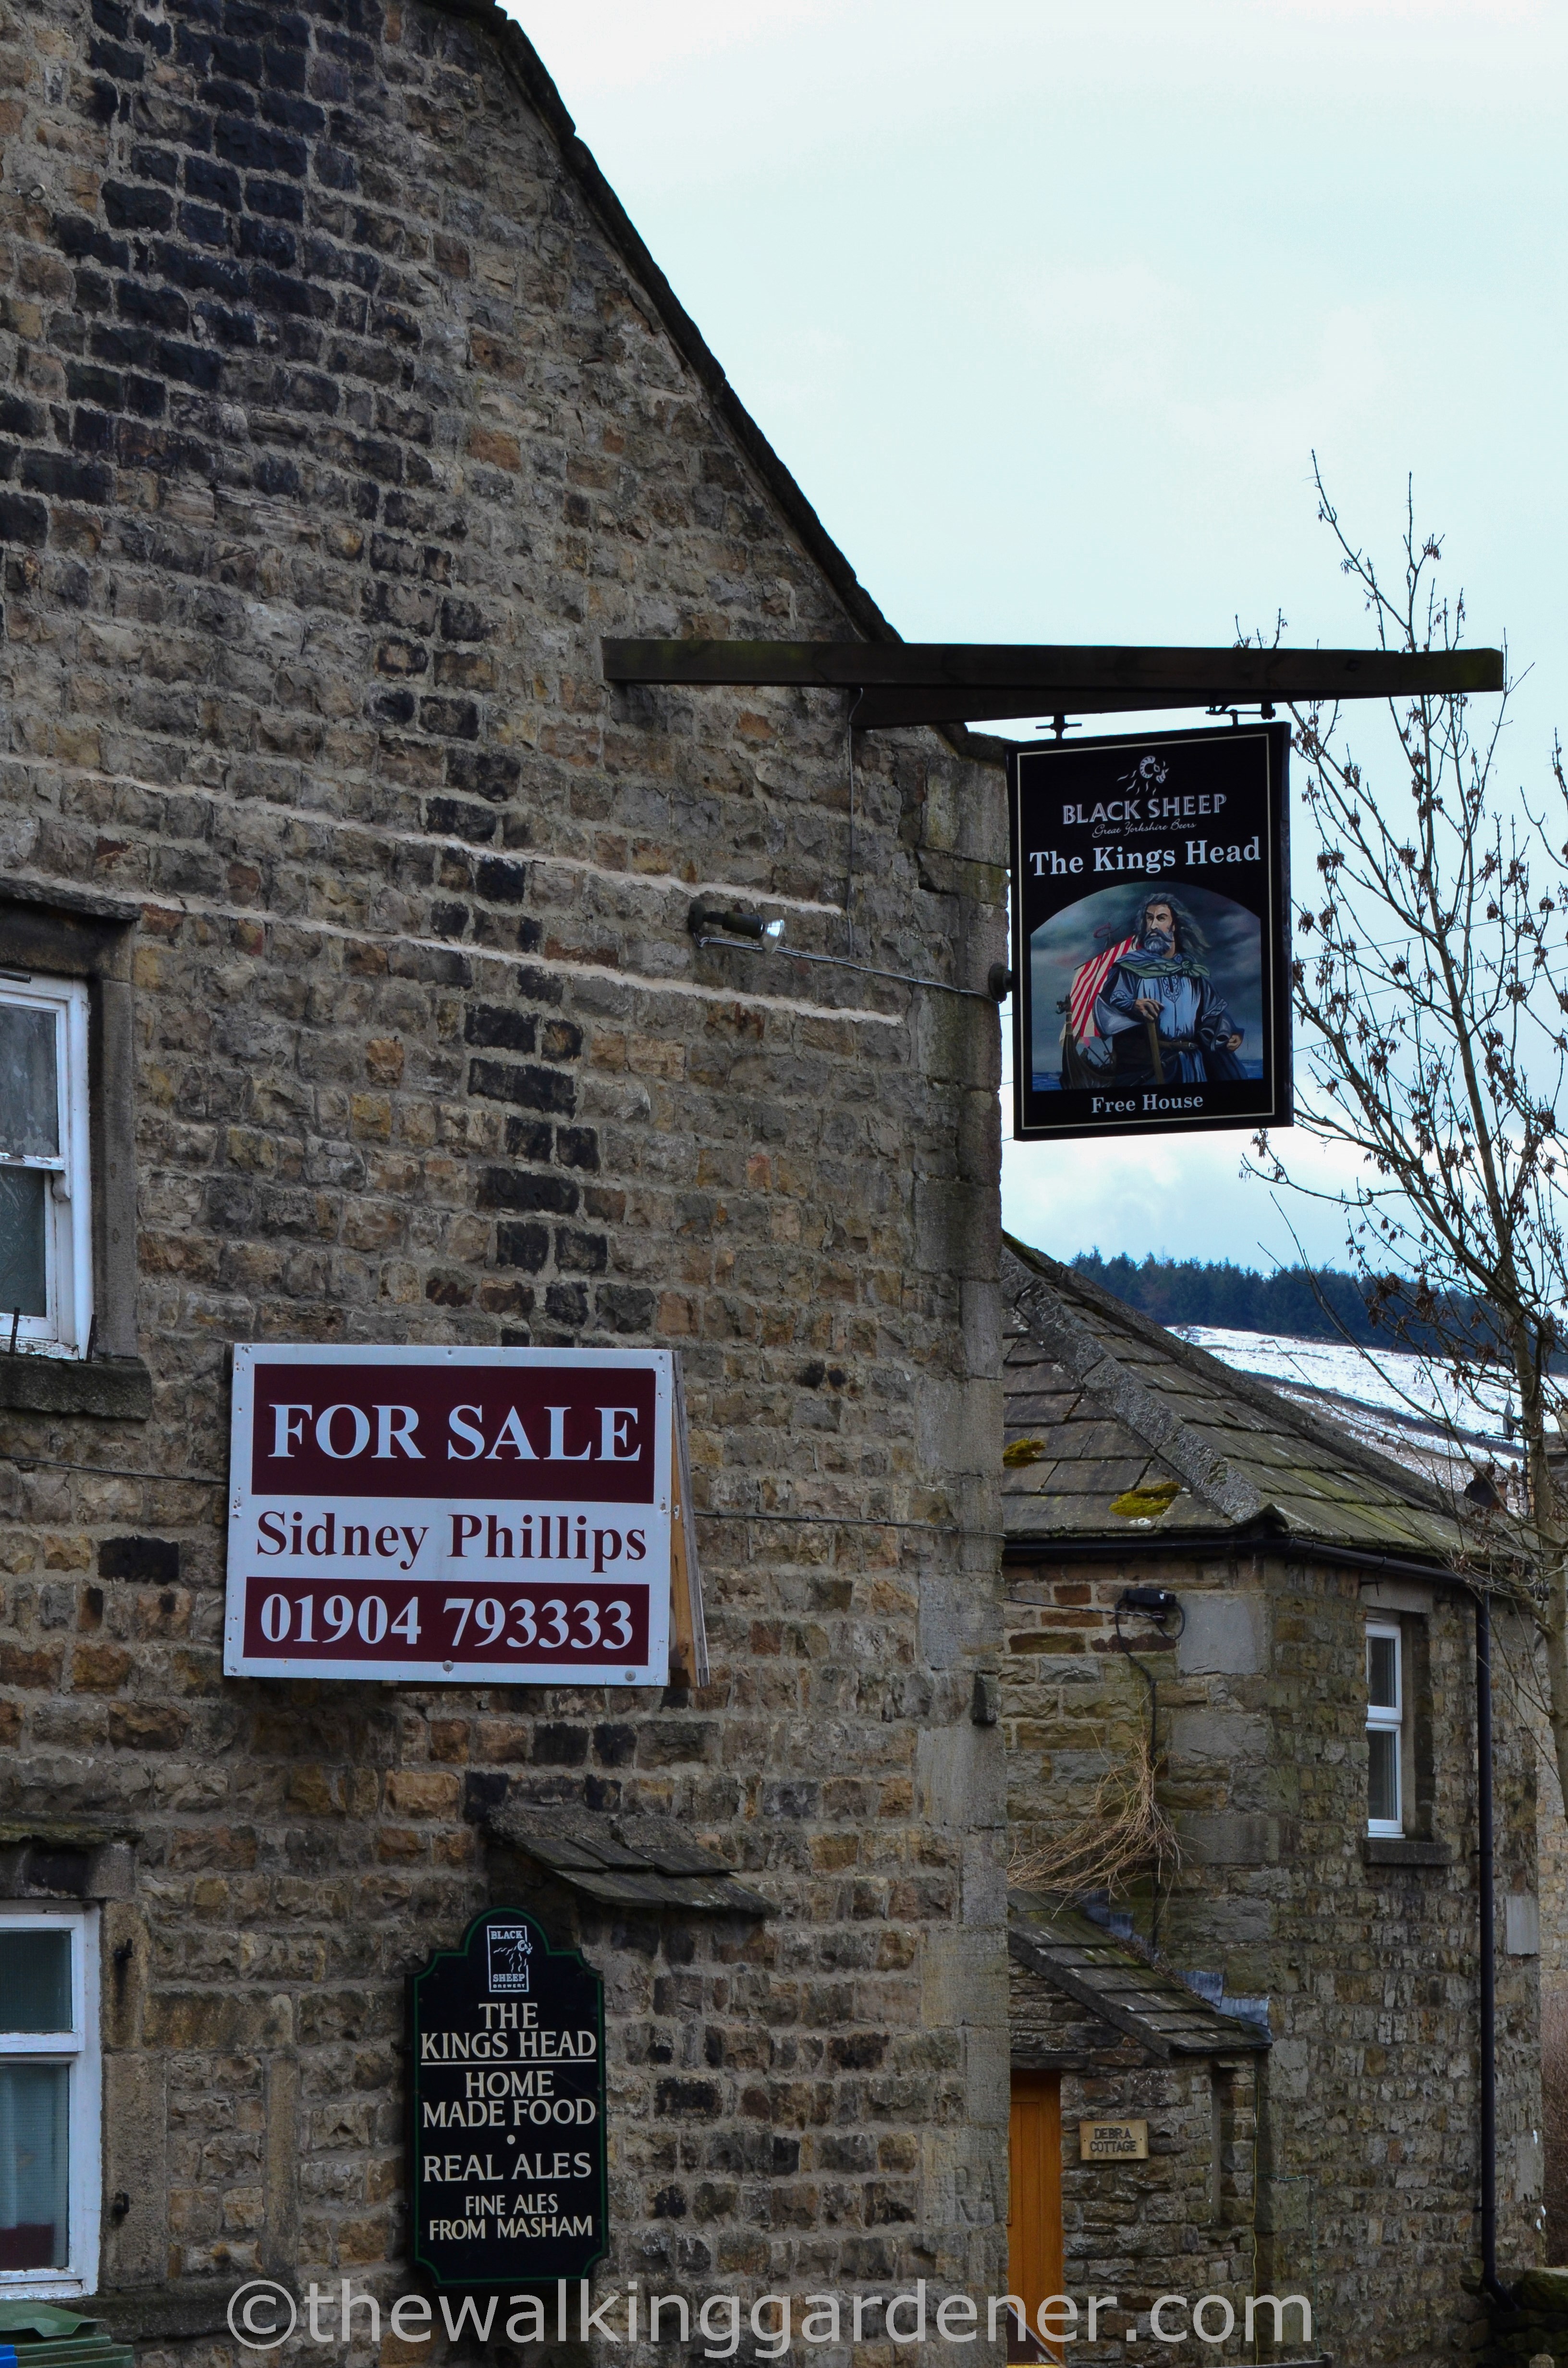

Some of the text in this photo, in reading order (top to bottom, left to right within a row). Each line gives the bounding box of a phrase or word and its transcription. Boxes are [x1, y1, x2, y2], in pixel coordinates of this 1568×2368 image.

[1063, 794, 1226, 825] BLACK SHEEP
[1092, 818, 1197, 838] Great Yorkshire Beers
[1030, 836, 1261, 876] The Kings Head
[1091, 1094, 1203, 1113] Free House
[267, 1404, 642, 1462] FOR SALE
[257, 1511, 646, 1573] Sidney Phillips
[260, 1593, 633, 1650] 01904 793333
[490, 1930, 523, 1939] BLACK
[493, 1973, 525, 1982] SHEEP
[478, 2003, 539, 2029] THE
[421, 2031, 596, 2059] KINGS HEAD
[466, 2071, 554, 2098] HOME
[423, 2098, 596, 2128] MADE FOOD
[1090, 2140, 1137, 2152] COTTAGE
[1094, 2127, 1132, 2139] DEBRA
[423, 2152, 592, 2182] REAL ALES
[466, 2194, 558, 2216] FINE ALES
[429, 2216, 593, 2240] FROM MASHAM
